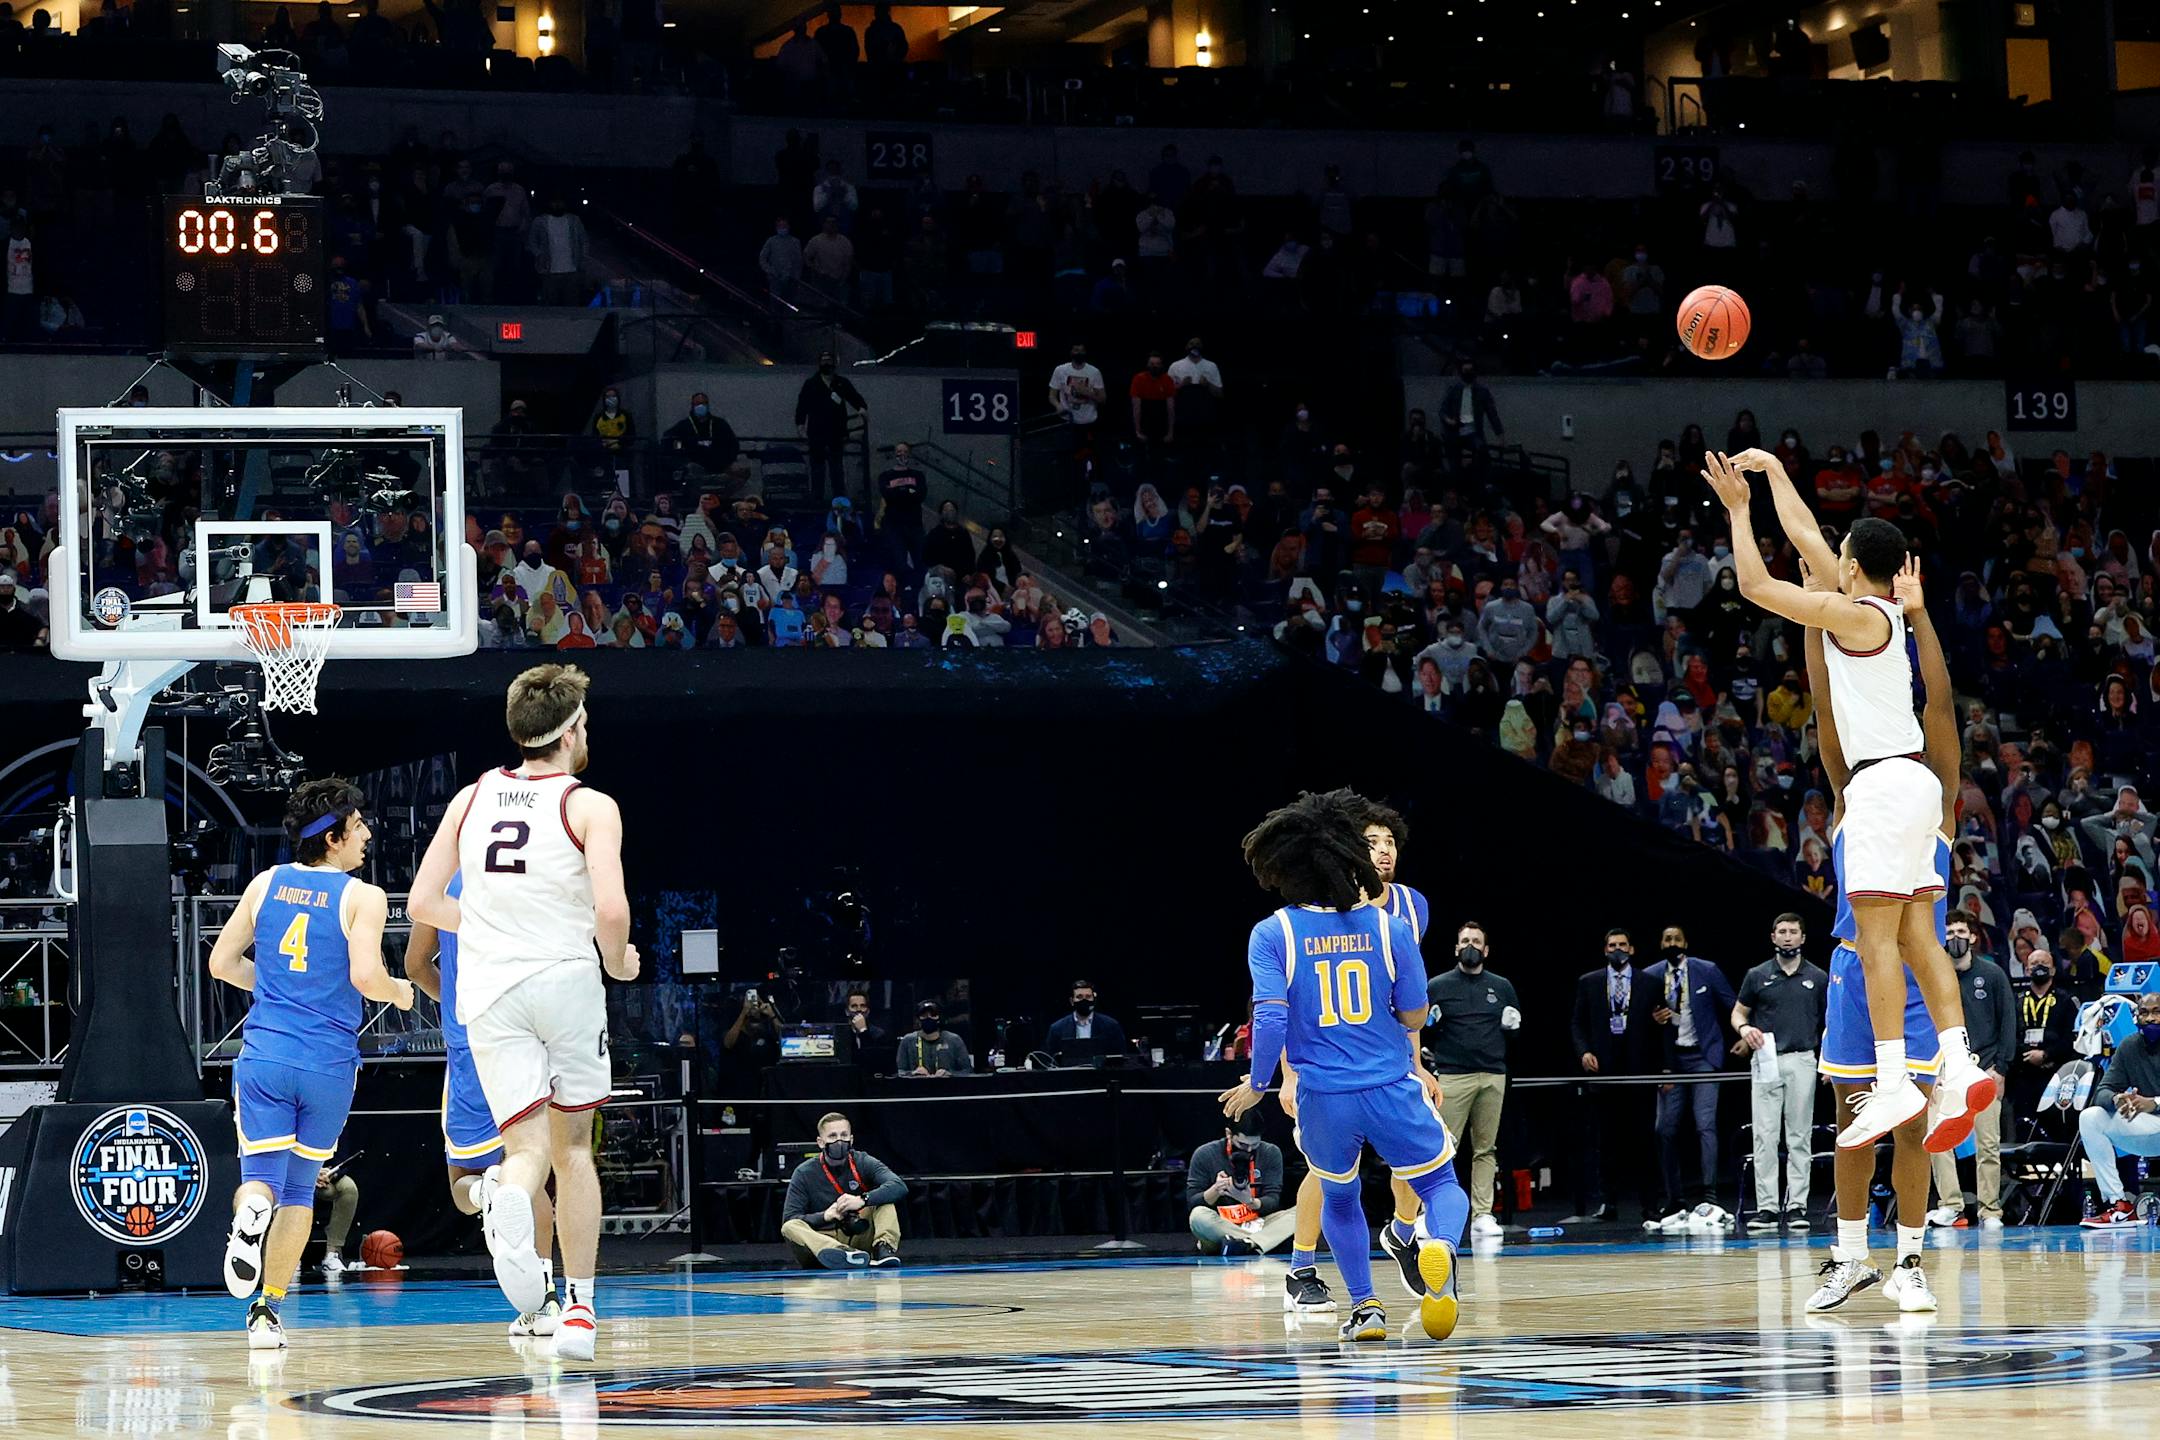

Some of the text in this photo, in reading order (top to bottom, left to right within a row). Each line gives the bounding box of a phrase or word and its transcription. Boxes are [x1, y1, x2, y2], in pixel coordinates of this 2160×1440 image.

[872, 142, 927, 168] 238
[1660, 156, 1714, 182] 239
[205, 196, 282, 205] DAKTRONICS
[178, 209, 279, 254] 00.6
[502, 323, 521, 339] EXIT
[1016, 331, 1035, 347] EXIT
[949, 392, 1010, 422] 138
[2013, 392, 2069, 419] 139
[497, 791, 540, 808] TIMME
[485, 821, 530, 873] 2
[273, 885, 329, 908] JAQUEZ JR.
[279, 912, 310, 973] 4
[1304, 933, 1374, 956] CAMPBELL
[1314, 959, 1373, 1027] 10
[114, 1138, 163, 1146] INDIANAPOLIS
[100, 1145, 178, 1171] FINAL
[102, 1176, 177, 1205] FOUR
